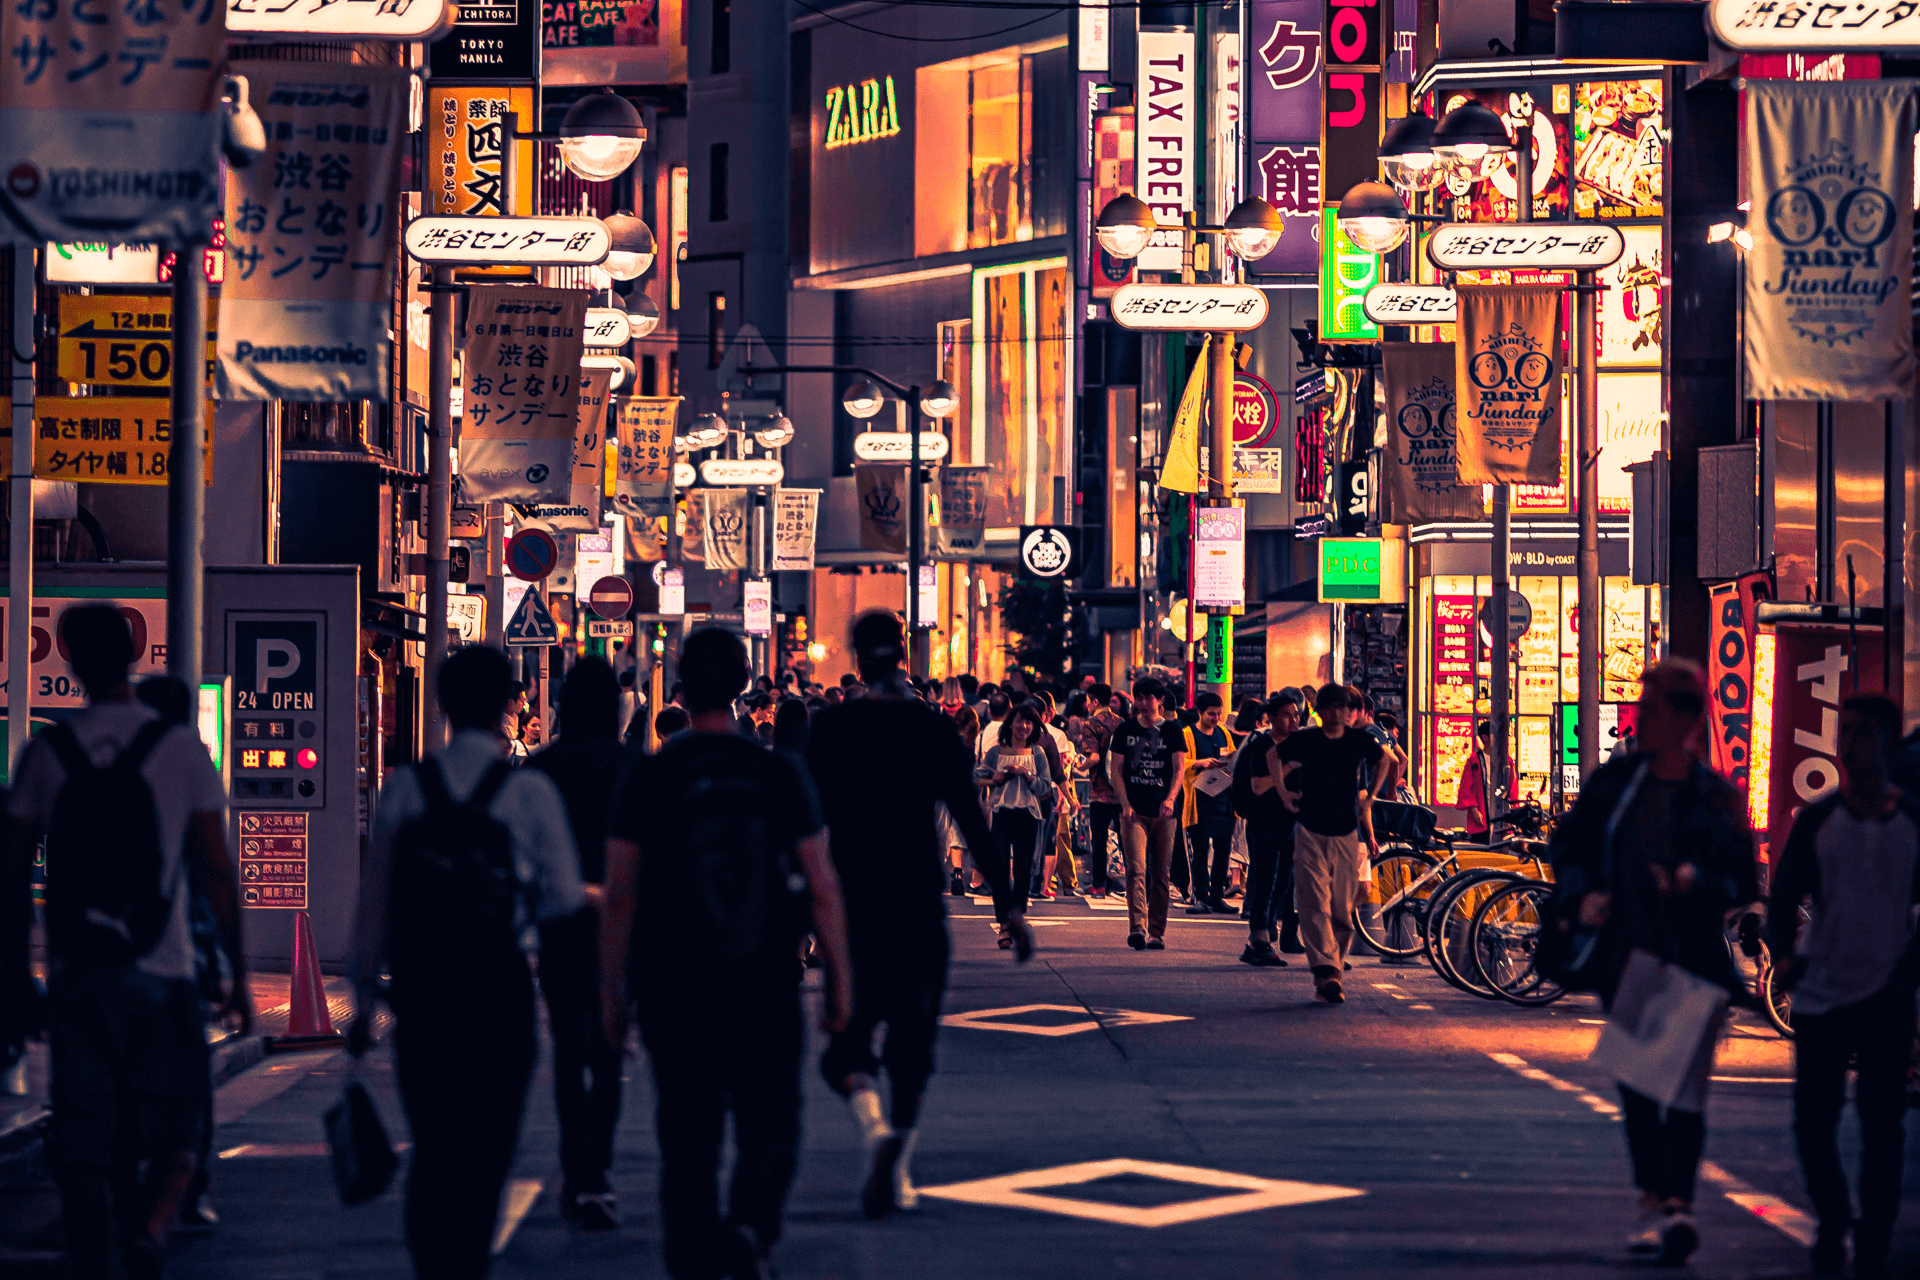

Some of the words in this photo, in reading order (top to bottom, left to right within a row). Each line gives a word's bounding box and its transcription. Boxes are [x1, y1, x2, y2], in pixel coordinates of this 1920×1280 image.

[543, 3, 576, 22] CAT
[580, 11, 619, 28] CAFE
[460, 40, 504, 49] TOKYO
[543, 26, 578, 46] AFE
[11, 35, 212, 85] サンデー
[460, 54, 504, 63] MANILA
[1148, 54, 1184, 122] TAX
[1556, 86, 1568, 110] 6
[826, 75, 901, 149] ZARA
[274, 152, 353, 192] 渋谷
[1148, 136, 1184, 218] FREE
[234, 199, 384, 238] おとなり
[418, 228, 595, 252] 渋谷センター街
[1443, 236, 1609, 255] 渋谷センター街
[234, 245, 385, 282] サンデー
[1763, 268, 1899, 307] Sunday
[1121, 297, 1259, 315] 渋谷センター街
[110, 311, 172, 329] 12時間
[236, 341, 368, 366] Panasonic
[498, 342, 549, 369] 渋谷
[470, 373, 570, 398] おとなり
[468, 401, 569, 427] サンデー
[1466, 401, 1556, 427] Sunday
[39, 416, 122, 441] 高さ制限
[633, 427, 661, 444] 渋谷
[620, 444, 671, 460] おとなり
[620, 460, 671, 476] サンデー
[536, 504, 589, 518] nasonic
[1451, 578, 1458, 592] 5
[1536, 579, 1543, 593] 7
[1622, 580, 1629, 594] 9
[256, 638, 301, 694] P
[238, 691, 258, 709] 24
[272, 691, 314, 710] OPEN
